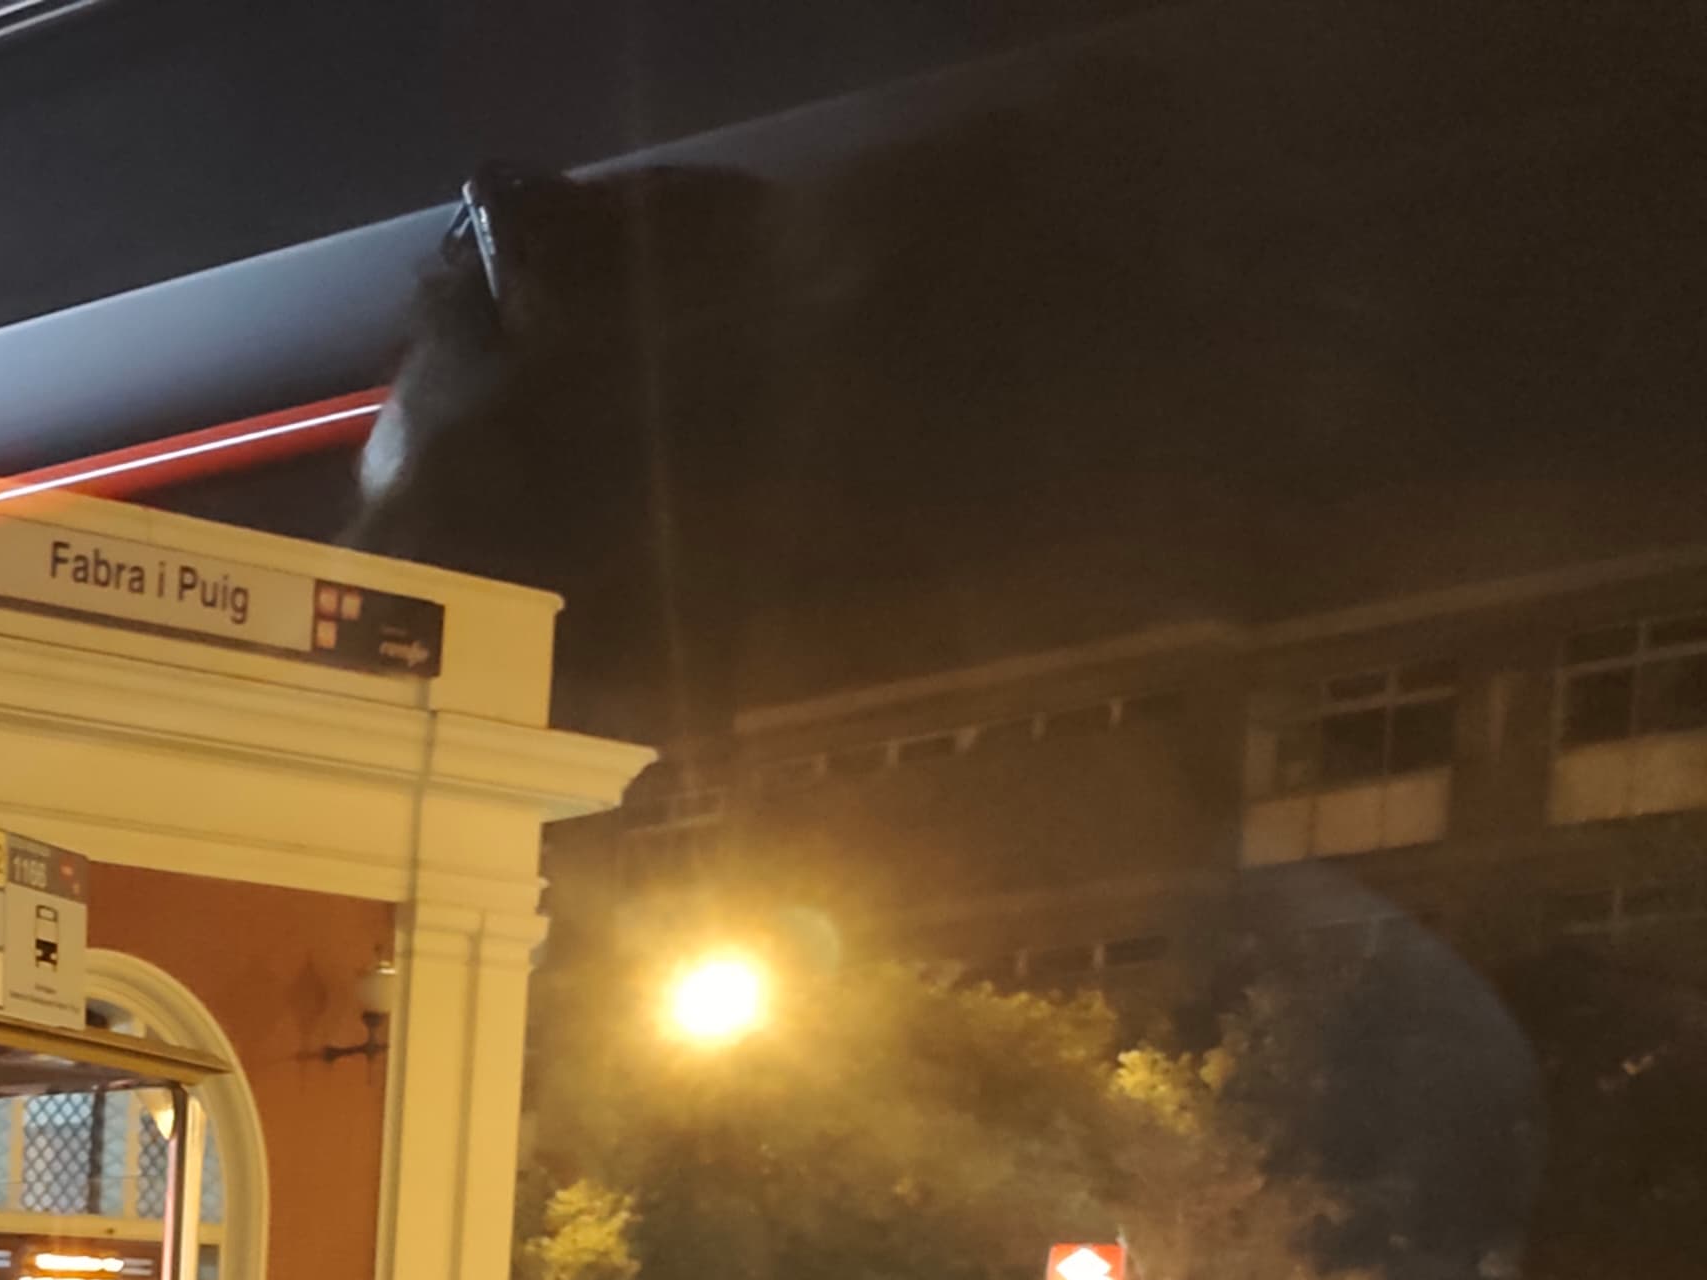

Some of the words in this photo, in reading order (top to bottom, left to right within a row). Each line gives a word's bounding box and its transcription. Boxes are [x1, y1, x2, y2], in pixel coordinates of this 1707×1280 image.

[49, 540, 146, 595] Fabra
[157, 561, 166, 598] i
[177, 565, 250, 625] Puig
